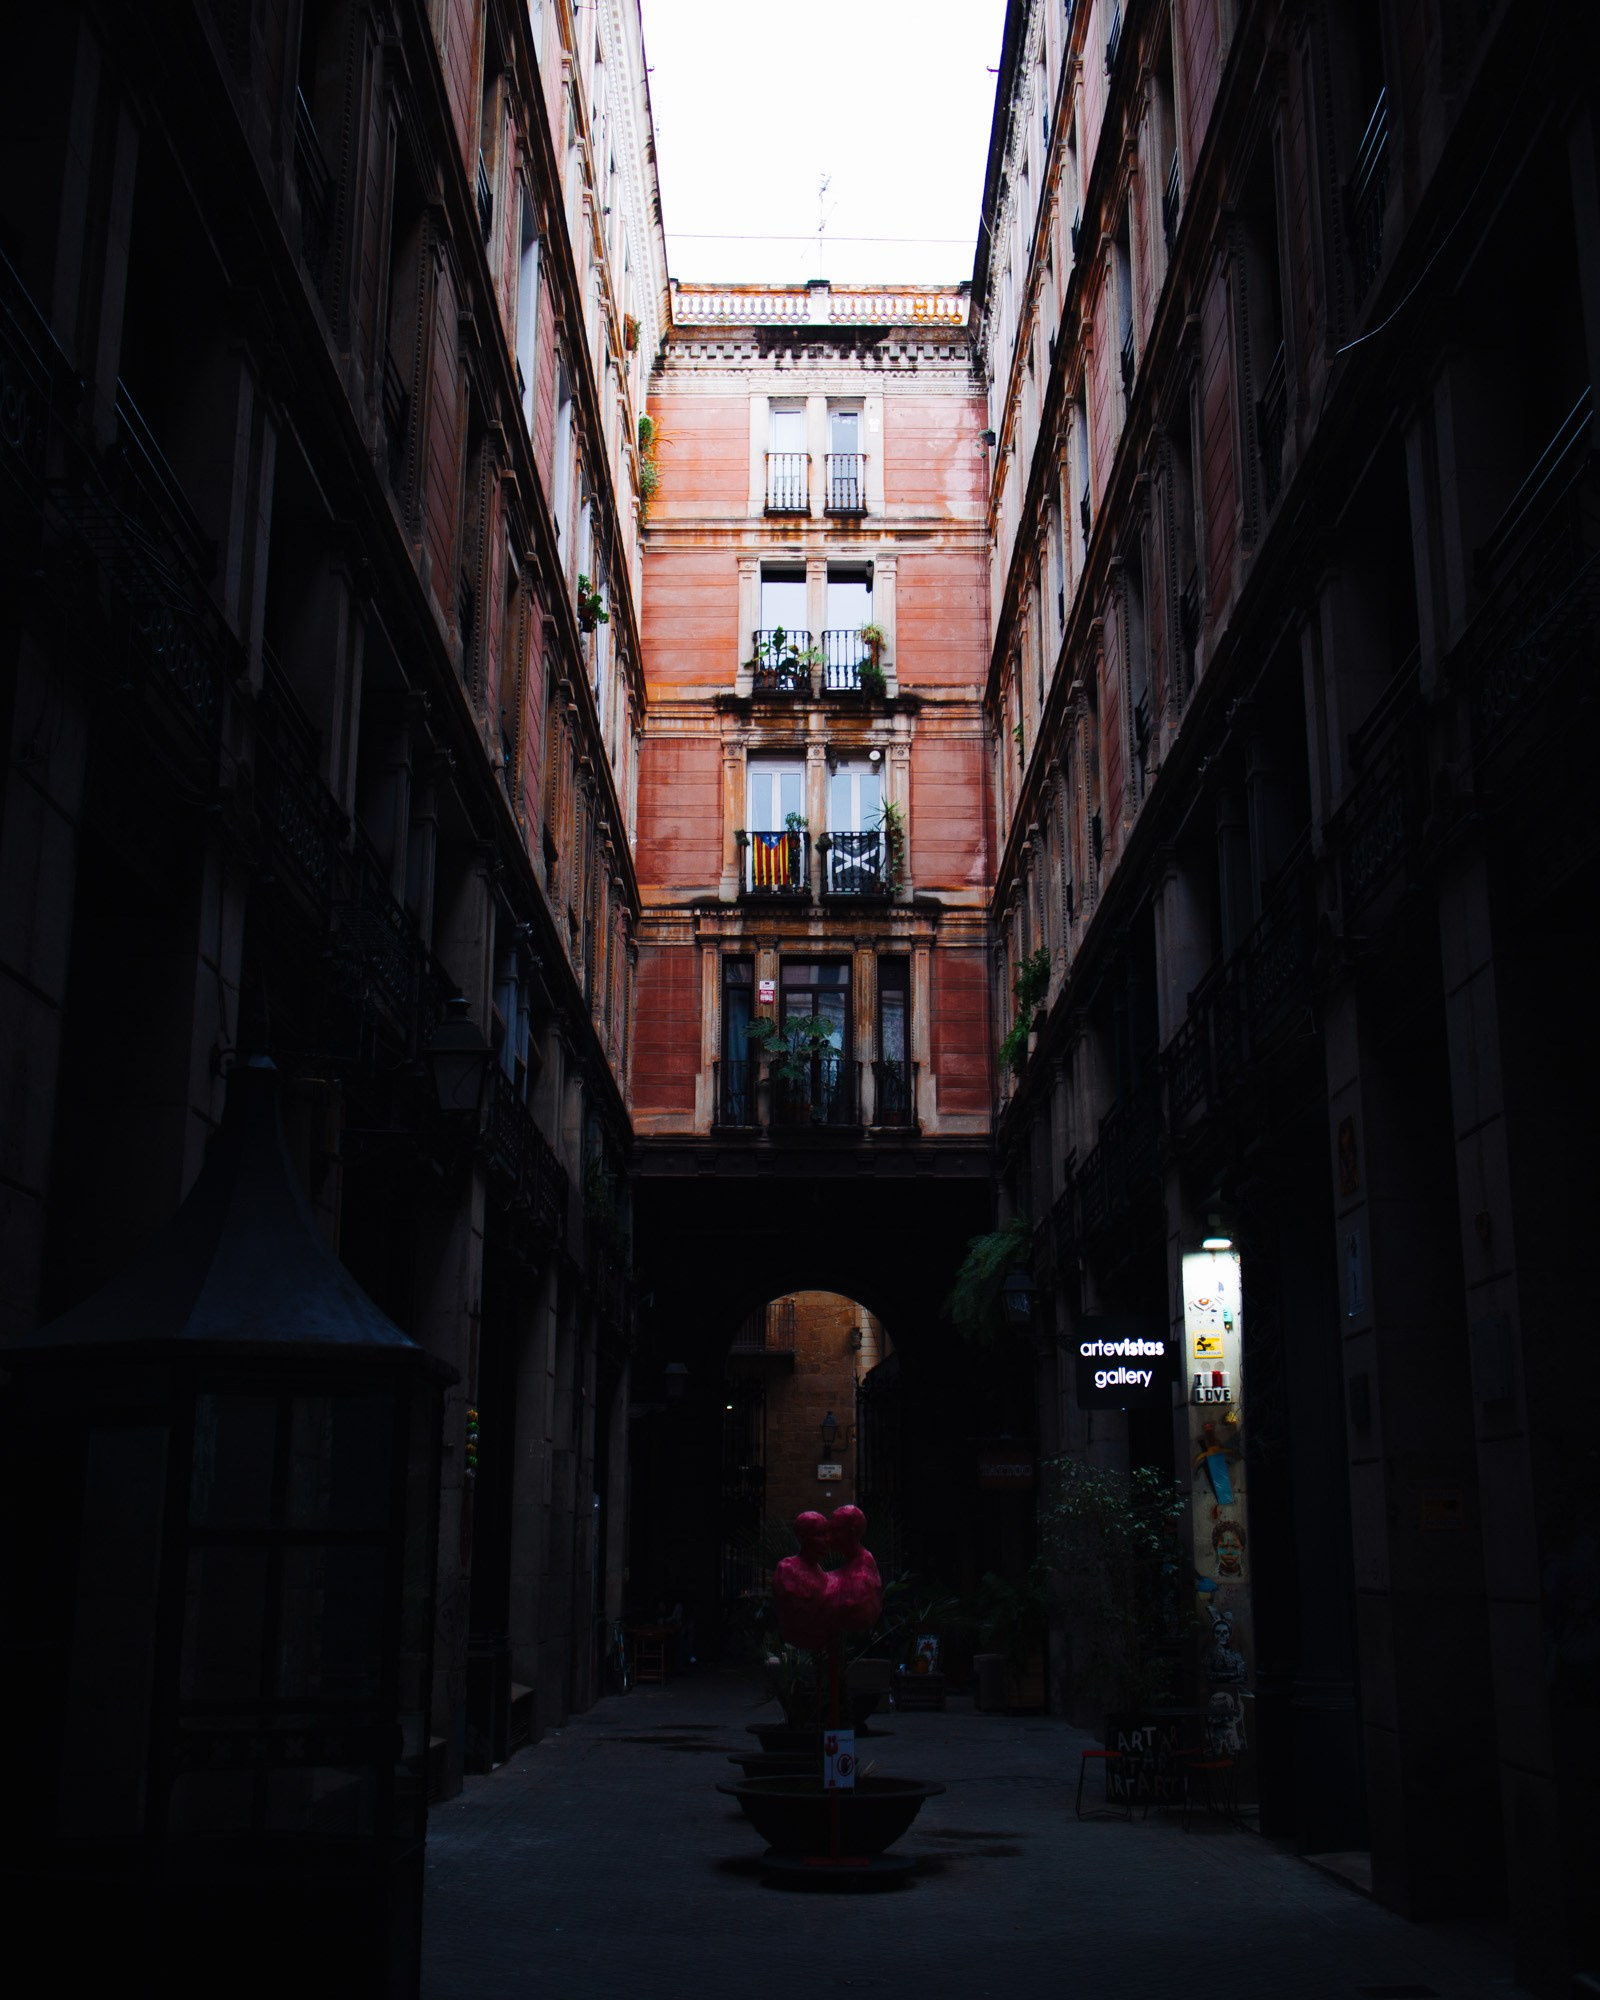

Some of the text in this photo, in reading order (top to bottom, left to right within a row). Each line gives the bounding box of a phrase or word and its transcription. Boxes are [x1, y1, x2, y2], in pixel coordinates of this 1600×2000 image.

[1080, 1338, 1164, 1356] artevistas
[1094, 1367, 1152, 1388] gallery
[1196, 1389, 1231, 1402] LOVE
[1118, 1726, 1157, 1752] ART
